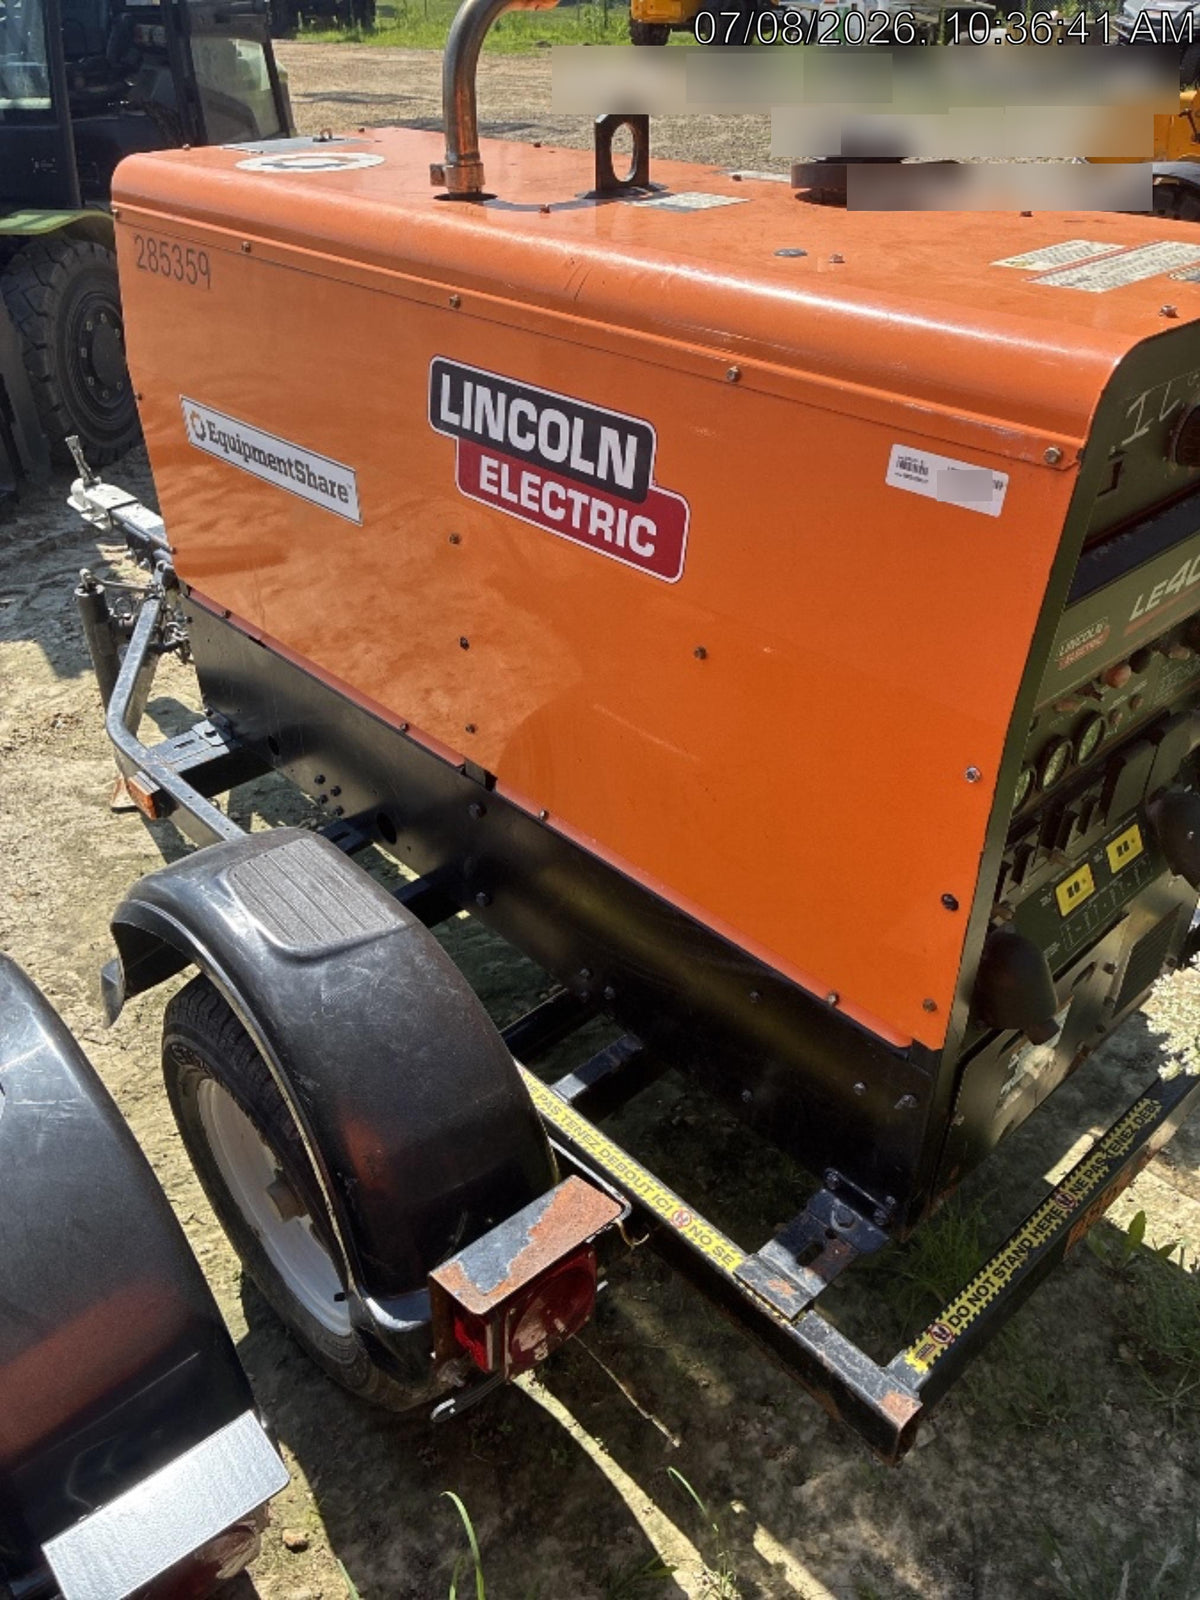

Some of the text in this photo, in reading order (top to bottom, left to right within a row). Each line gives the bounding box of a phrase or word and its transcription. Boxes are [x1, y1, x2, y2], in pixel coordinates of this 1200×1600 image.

[134, 234, 211, 290] 285359
[206, 419, 350, 504] EquipmentShare
[440, 374, 638, 490] LINCOLN
[479, 455, 657, 557] ELECTRIC
[561, 1112, 602, 1150] TENEZ
[599, 1147, 655, 1194] DEBOUT
[652, 1193, 673, 1212] ICI
[689, 1225, 712, 1246] NO
[712, 1245, 736, 1267] SE
[949, 1305, 970, 1327] DO
[966, 1276, 996, 1307] NOT
[992, 1238, 1033, 1279] STAND
[1029, 1205, 1065, 1240] HERE
[1068, 1176, 1089, 1195] NE
